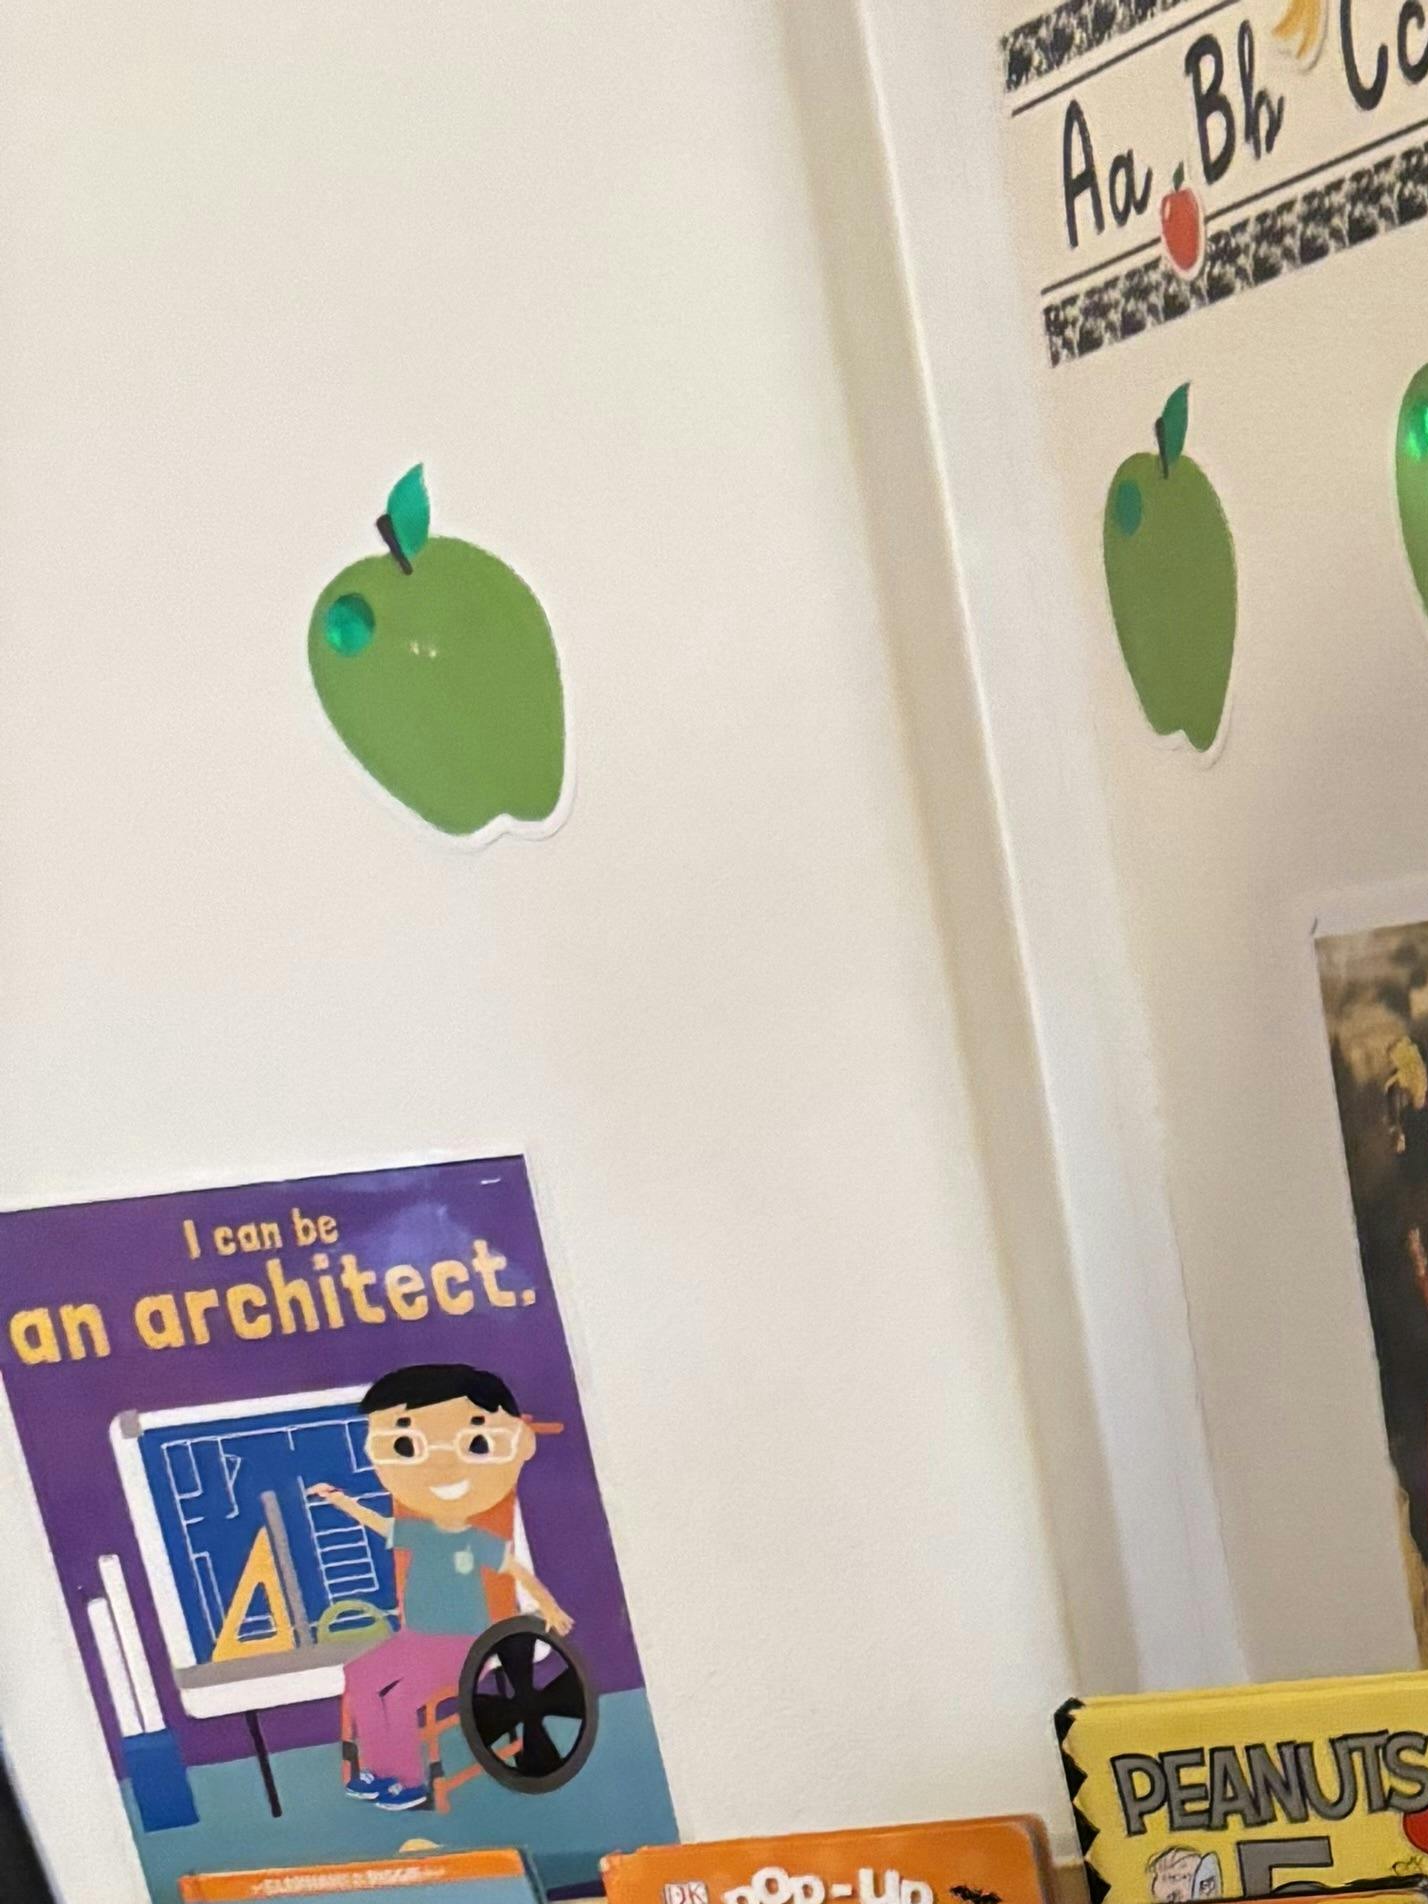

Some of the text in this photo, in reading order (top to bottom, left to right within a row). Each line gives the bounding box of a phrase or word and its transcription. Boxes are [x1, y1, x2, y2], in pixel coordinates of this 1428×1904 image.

[1061, 98, 1154, 249] Aa
[1184, 17, 1286, 186] Bb
[183, 1208, 340, 1259] I can be
[9, 1238, 538, 1367] an architect.
